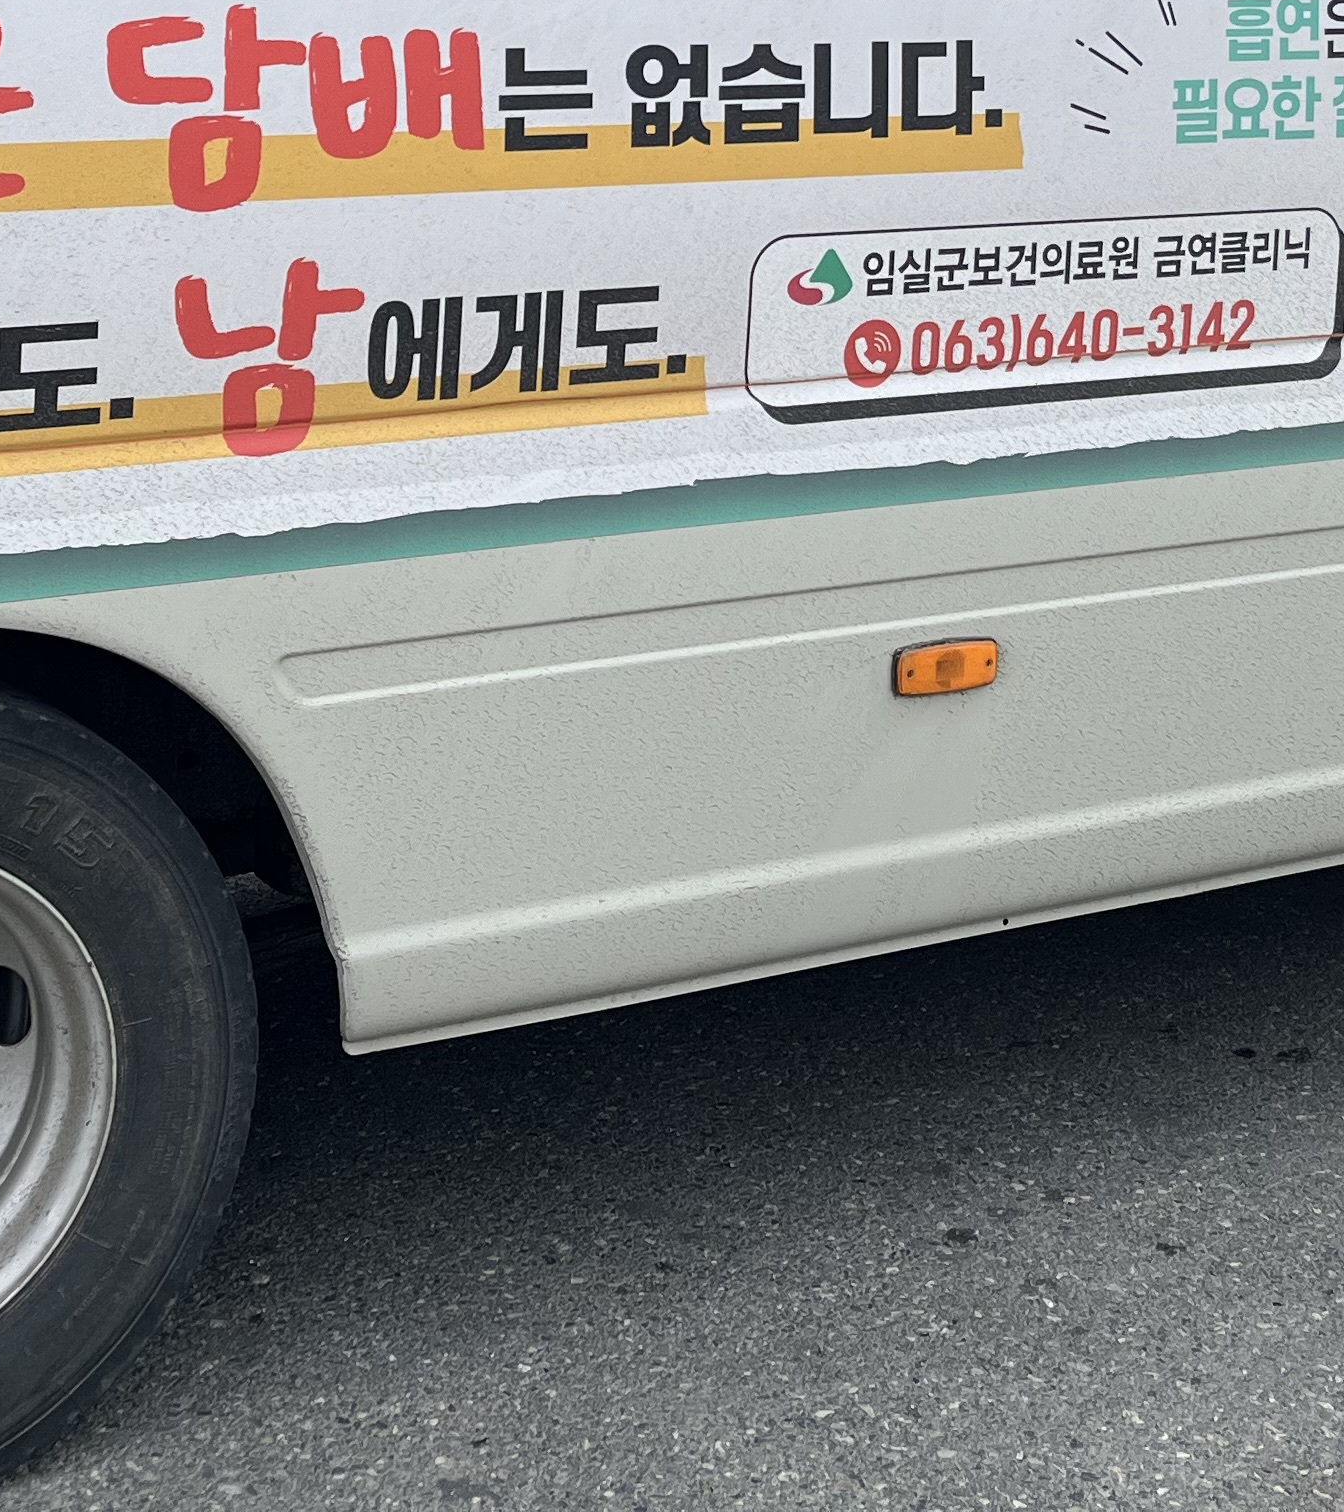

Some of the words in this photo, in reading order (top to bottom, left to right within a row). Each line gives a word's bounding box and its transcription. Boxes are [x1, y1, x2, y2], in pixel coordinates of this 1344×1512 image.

[108, 5, 593, 211] 담배는
[626, 40, 1002, 147] 없습니다.
[1172, 75, 1322, 144] 필요한
[863, 232, 1139, 297] 임실군보건의료원
[1154, 227, 1311, 278] 금연클리닉
[175, 258, 687, 457] 남에게도.
[911, 300, 1255, 375] 063)640-3142
